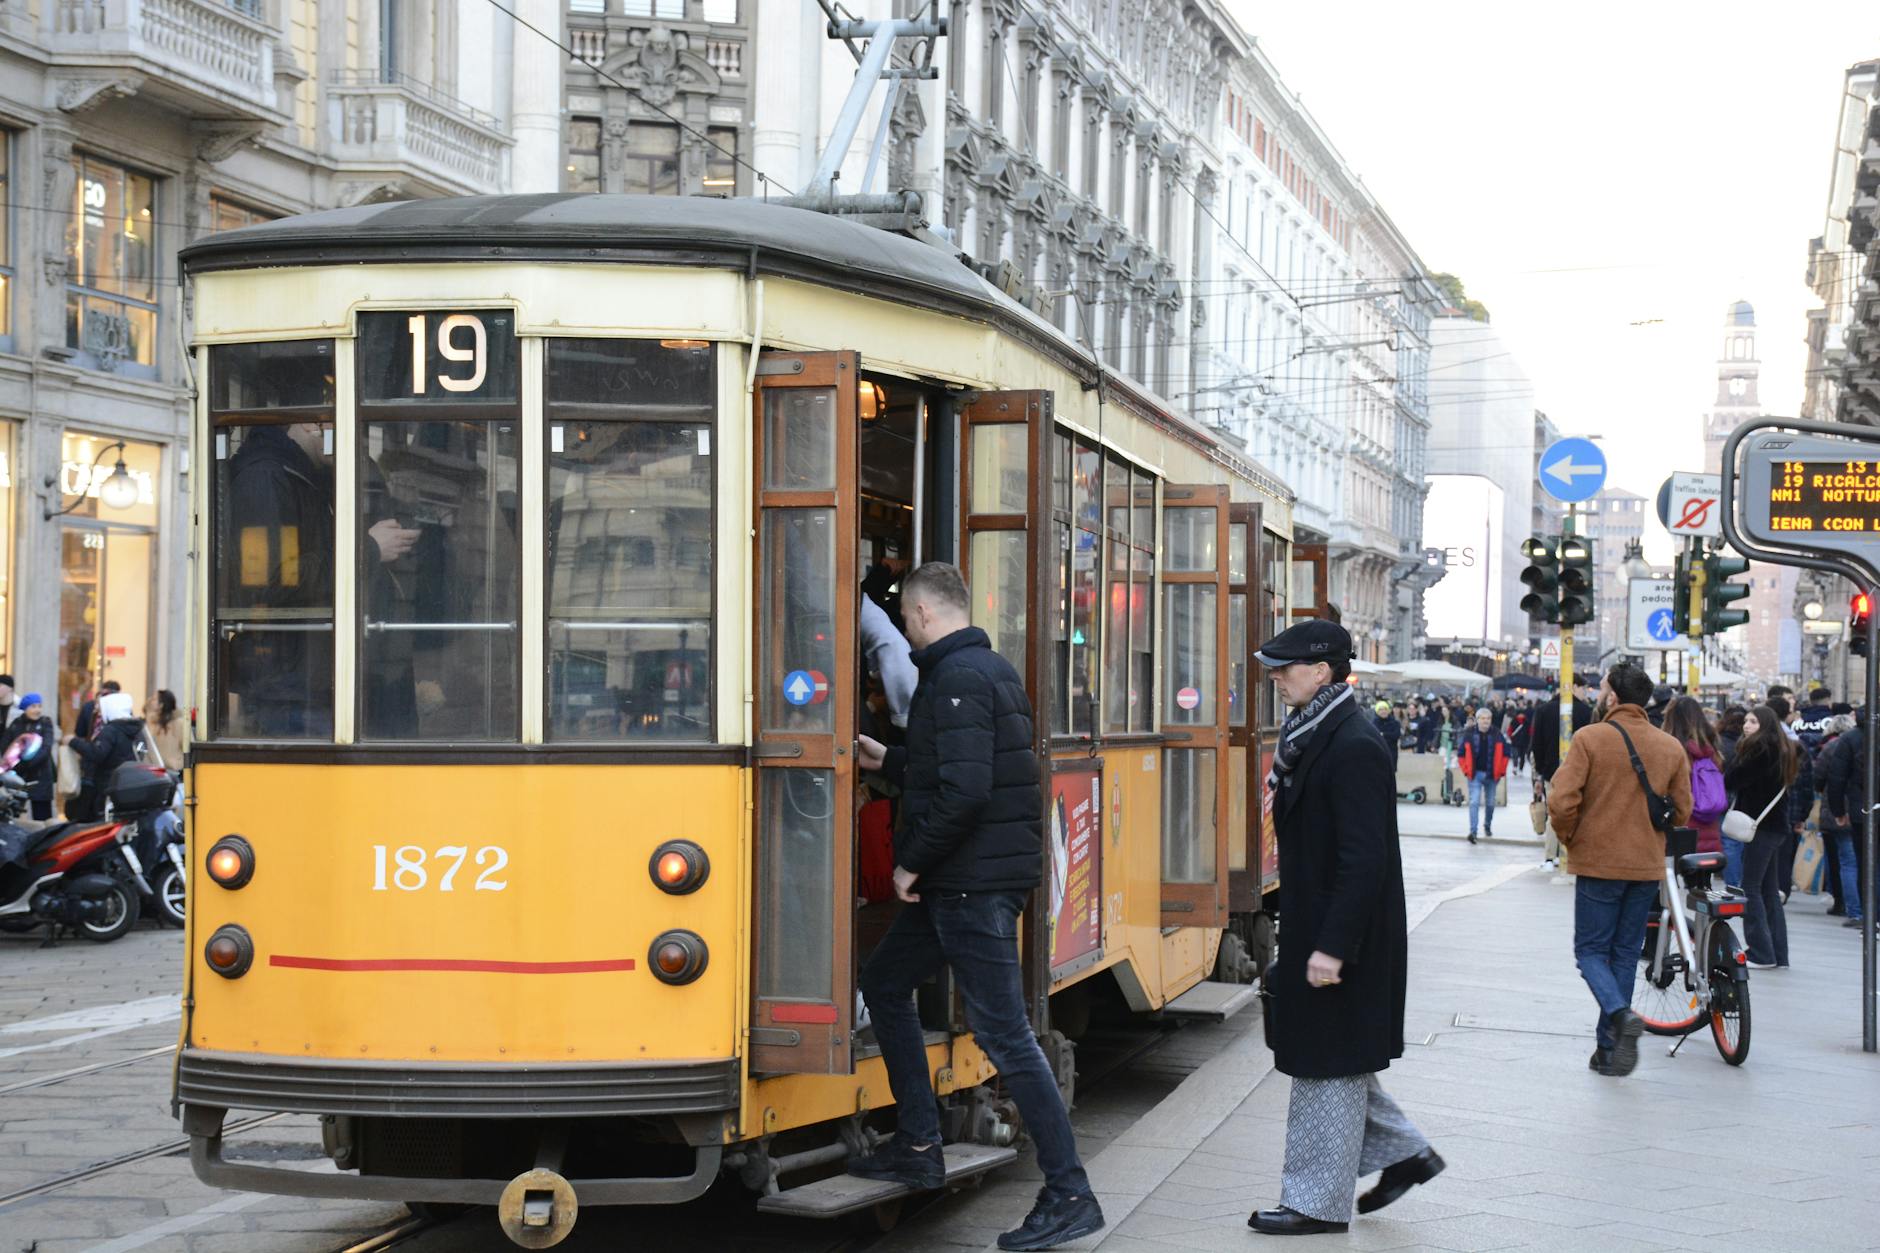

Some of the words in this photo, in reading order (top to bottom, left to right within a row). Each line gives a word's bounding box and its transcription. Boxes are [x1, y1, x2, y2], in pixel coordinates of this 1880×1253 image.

[408, 314, 487, 394] 19
[1784, 461, 1804, 473] 16
[1846, 461, 1867, 473] 13
[1784, 475, 1804, 487] 19
[1771, 489, 1801, 502] NM1
[1771, 517, 1812, 530] IENA
[372, 844, 509, 892] 1872
